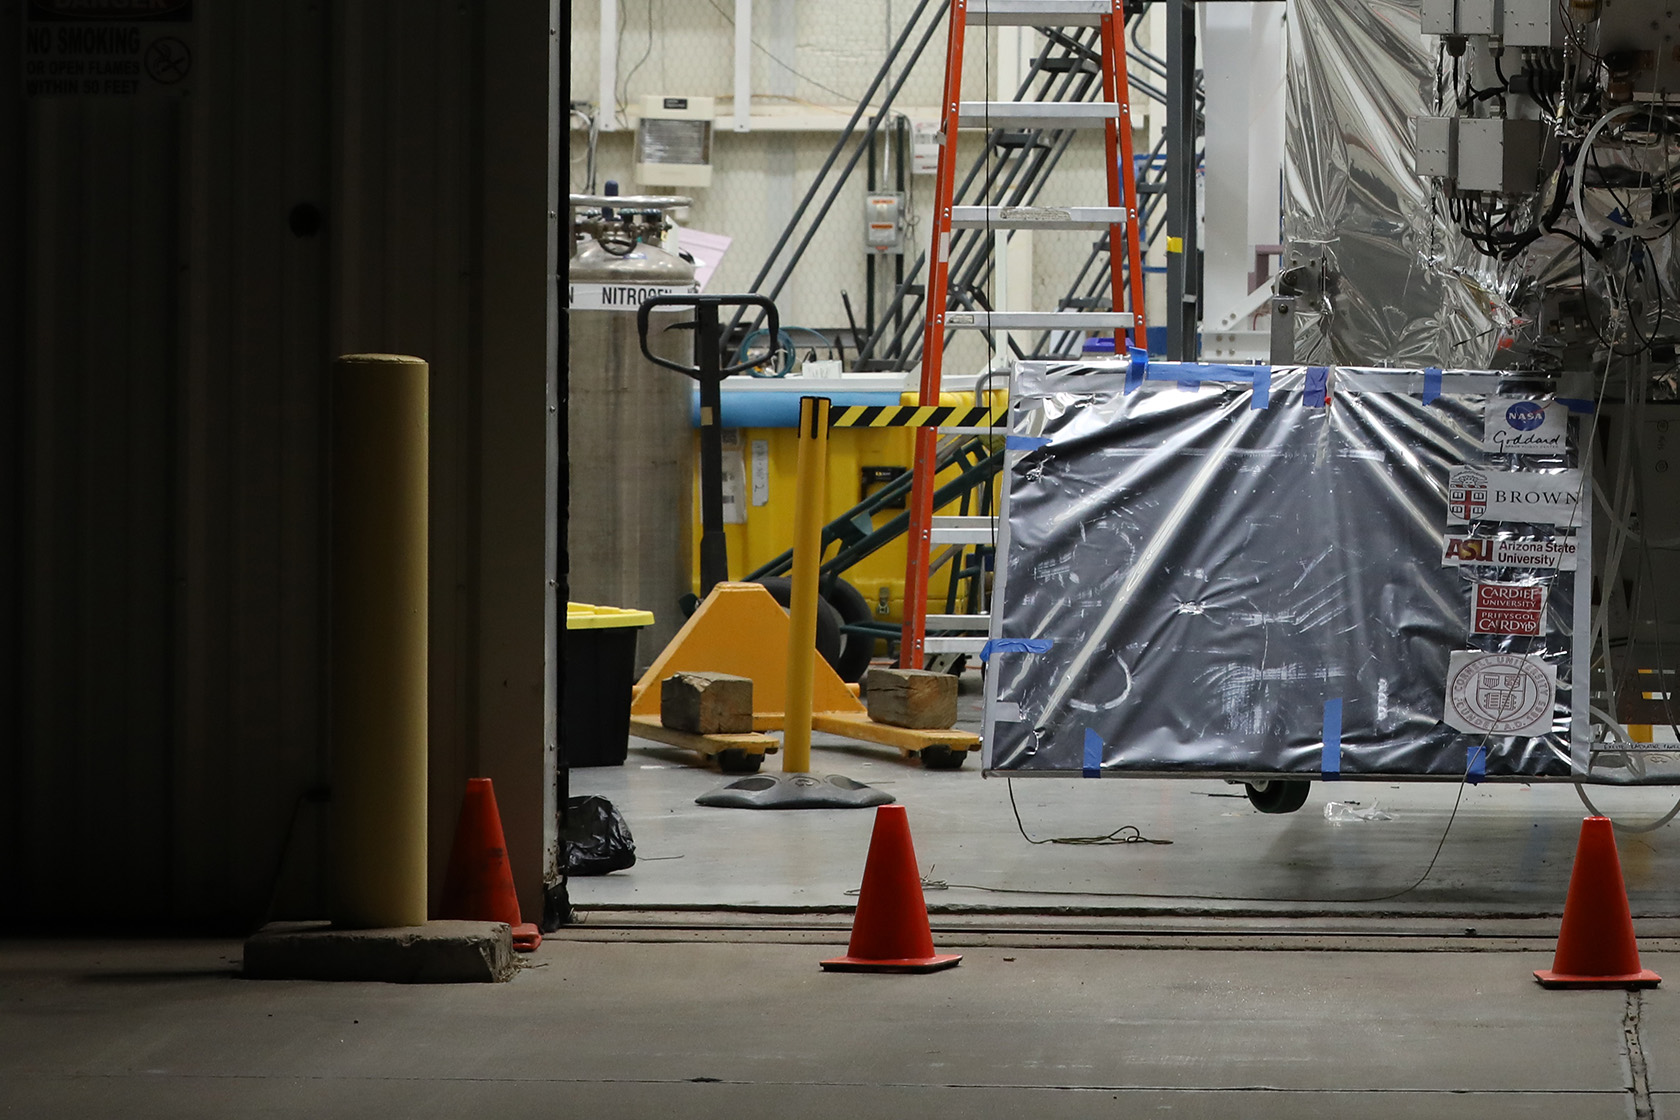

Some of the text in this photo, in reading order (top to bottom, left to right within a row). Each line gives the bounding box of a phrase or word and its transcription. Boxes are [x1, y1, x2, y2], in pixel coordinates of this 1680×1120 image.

[26, 26, 141, 55] NO SMOKING
[26, 60, 141, 75] OR OPEN FLAMES
[26, 78, 140, 95] WITHIN 50 FEET
[1508, 411, 1543, 421] NASA
[1492, 430, 1561, 455] Goddard
[1495, 490, 1579, 505] BROWN
[1444, 538, 1495, 562] ASU
[1499, 541, 1576, 554] Arizona State
[1498, 552, 1556, 567] University
[1481, 586, 1542, 600] CARDIFF
[1482, 599, 1537, 608] UNIVERSITY
[1454, 657, 1493, 693] CORNELL
